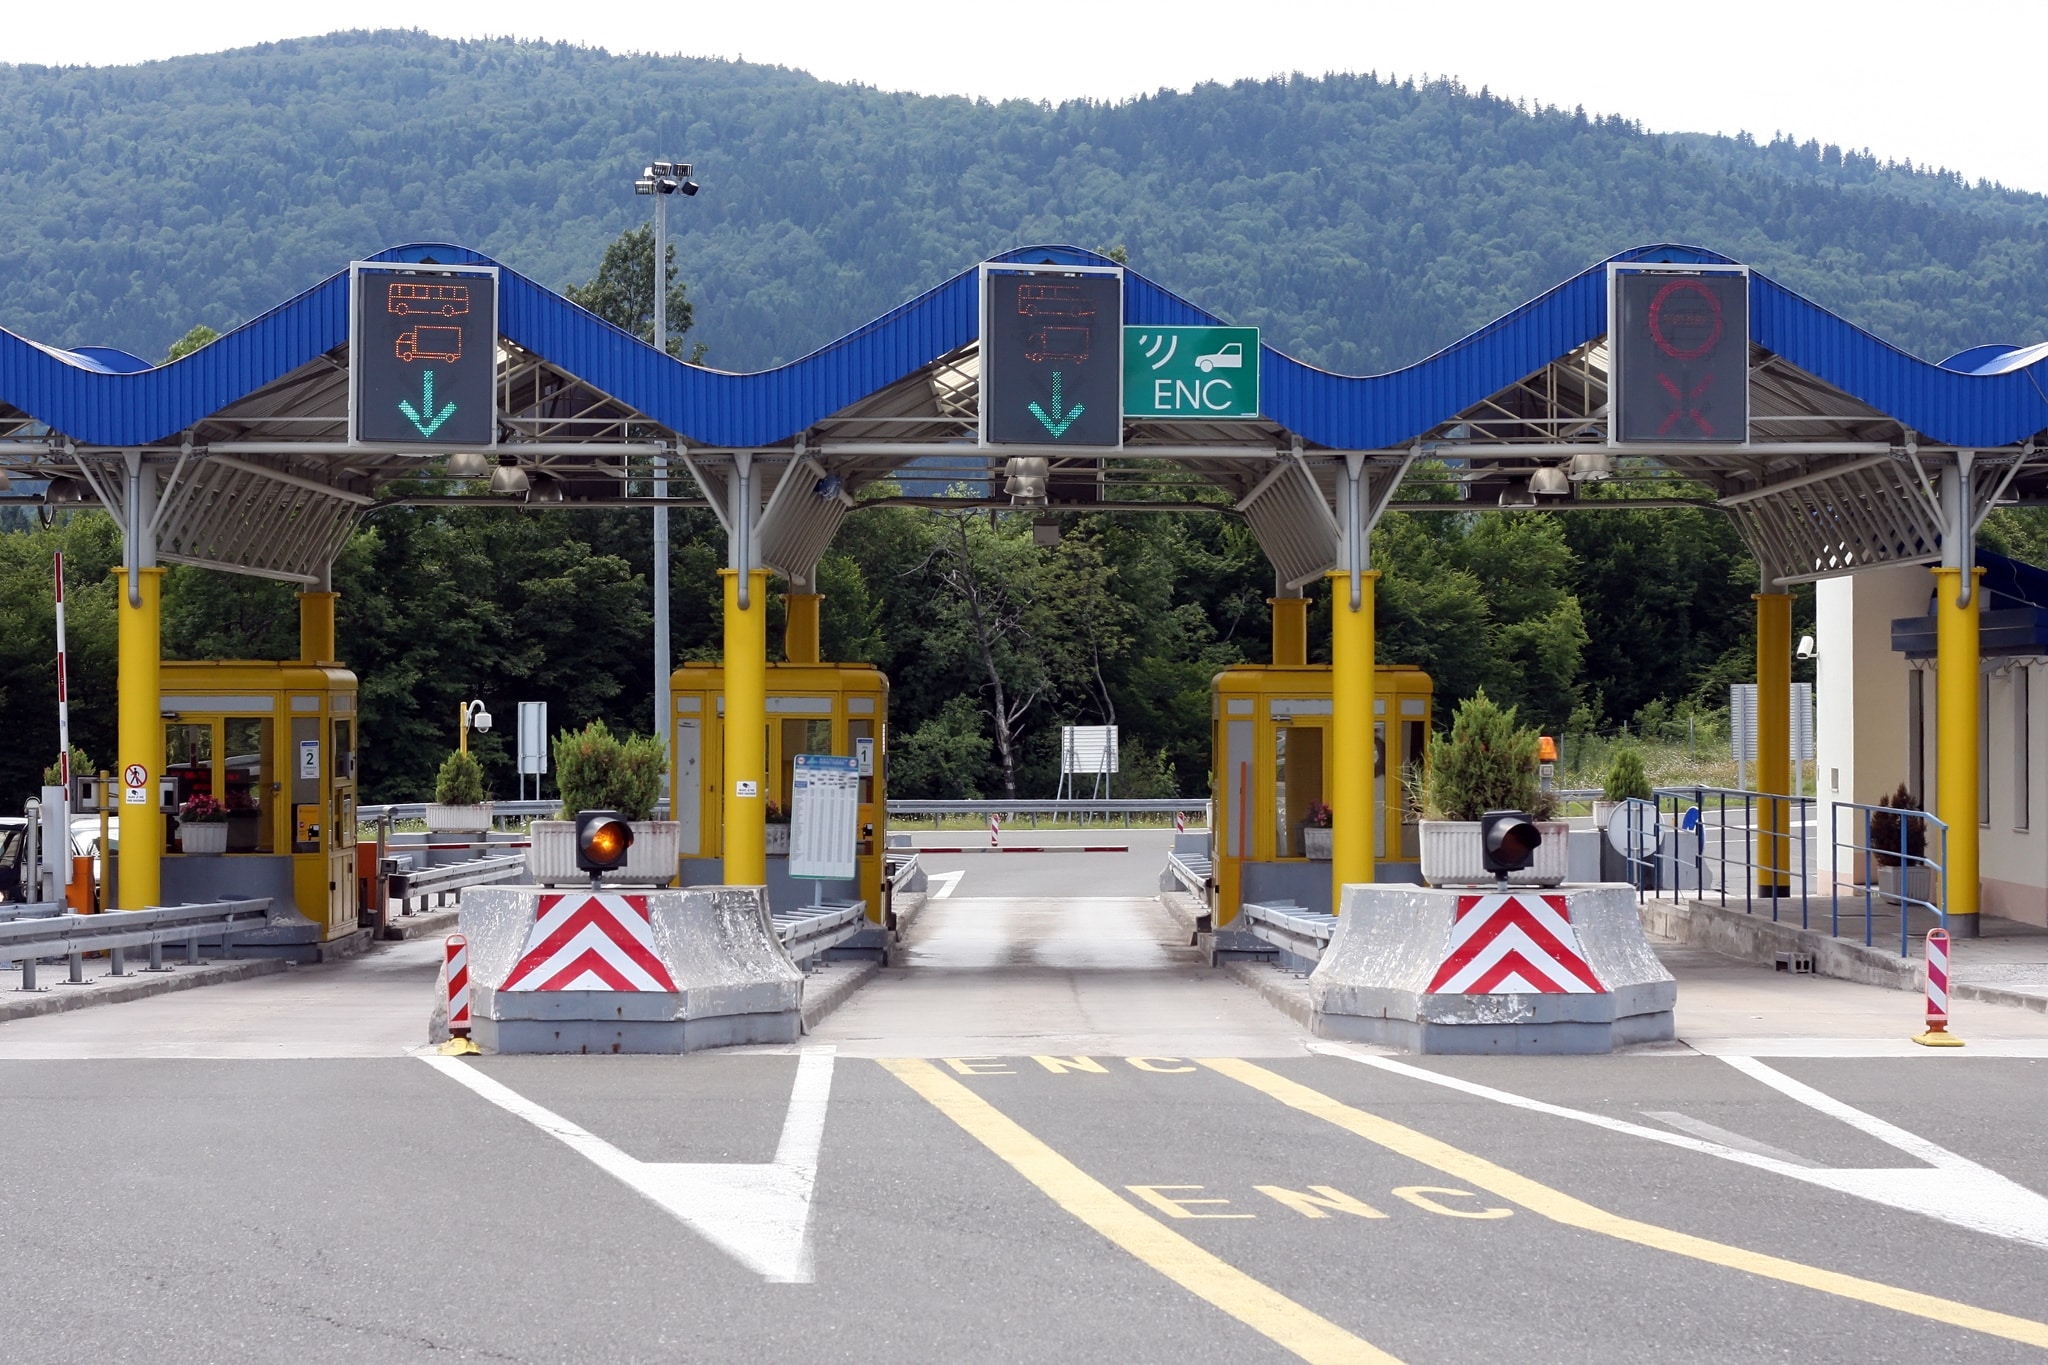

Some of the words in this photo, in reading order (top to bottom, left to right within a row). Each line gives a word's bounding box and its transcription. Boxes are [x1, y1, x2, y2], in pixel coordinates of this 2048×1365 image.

[1154, 379, 1233, 411] ENC
[306, 752, 314, 765] 2
[860, 749, 867, 762] 1
[941, 1055, 1197, 1075] ENC
[1123, 1184, 1515, 1220] ENC
